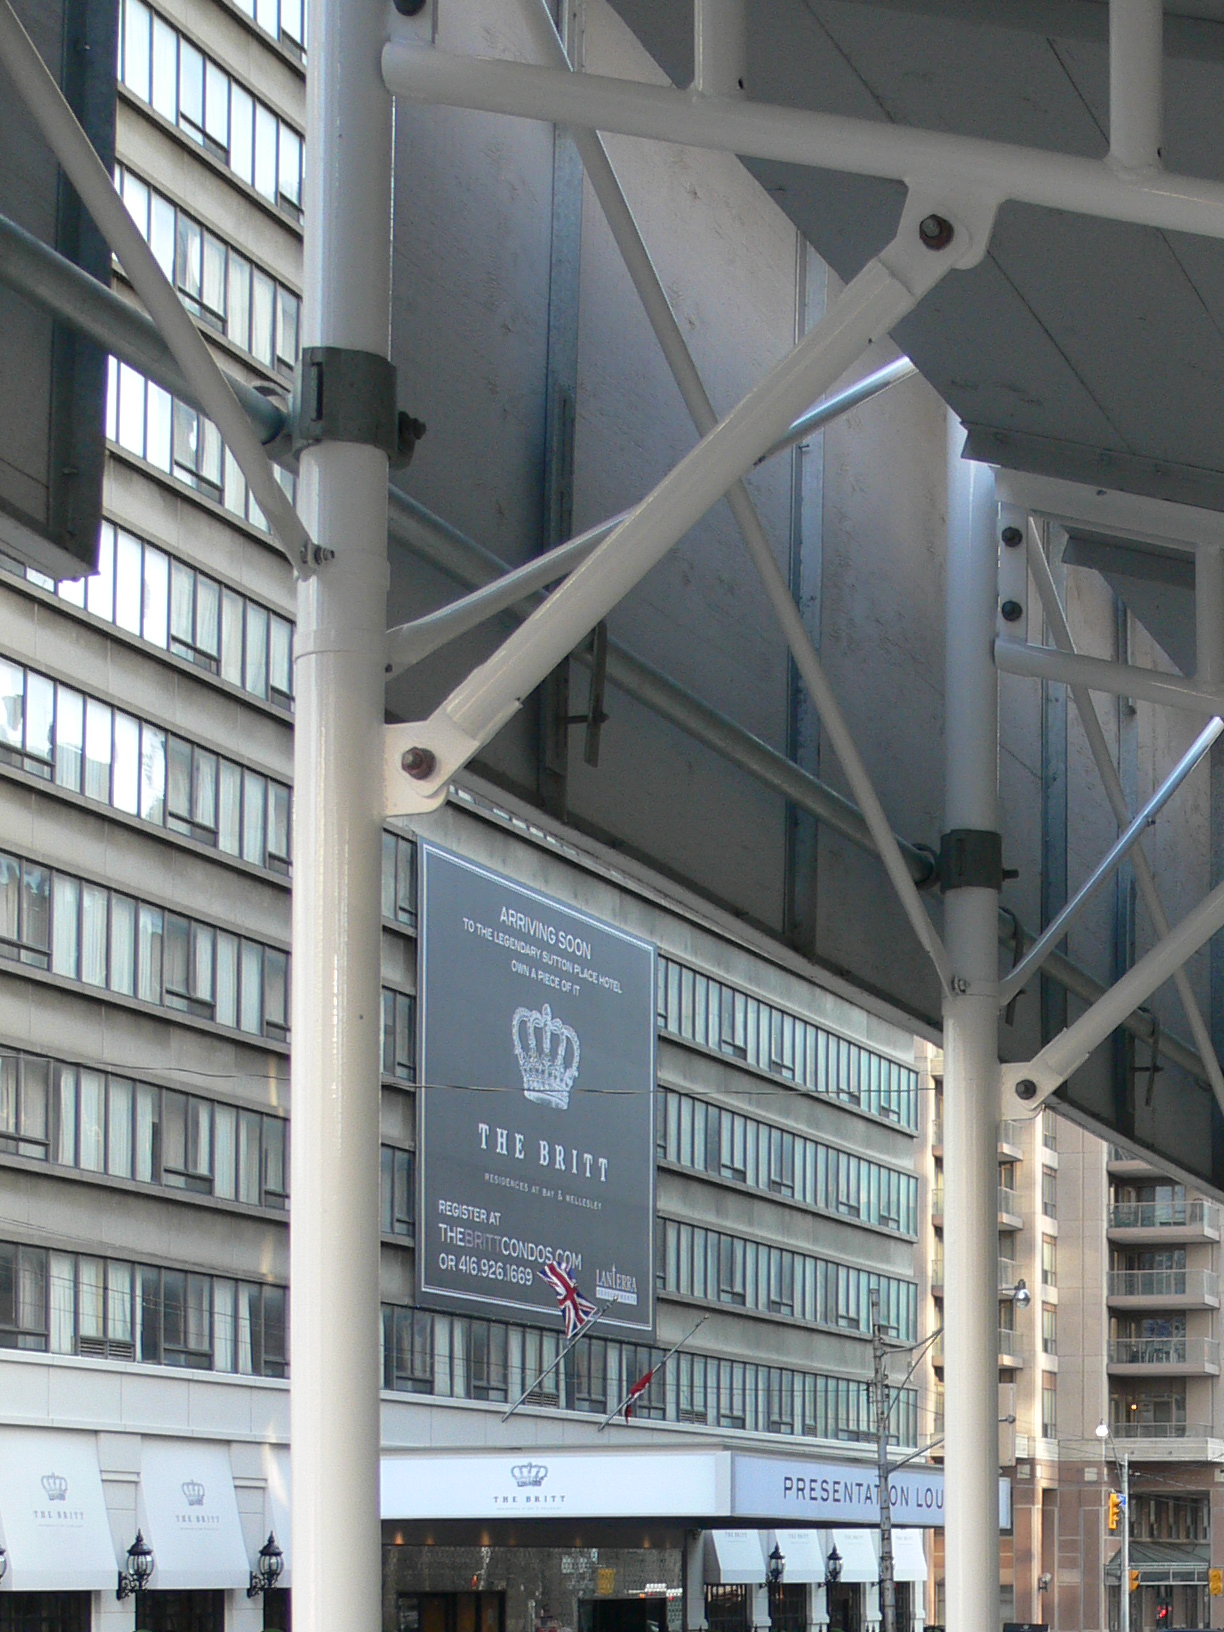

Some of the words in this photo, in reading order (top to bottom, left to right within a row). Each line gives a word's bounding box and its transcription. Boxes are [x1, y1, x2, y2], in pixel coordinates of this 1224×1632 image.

[500, 906, 556, 944] ARRIVING
[558, 931, 591, 960] SOON
[463, 917, 475, 932] TO
[476, 923, 493, 940] THE
[494, 931, 541, 960] LEGENDARY
[542, 951, 573, 974] SUTTON
[574, 964, 598, 984] PLACE
[599, 975, 623, 993] HOTEL
[511, 960, 529, 977] OWN
[531, 968, 537, 979] A
[538, 970, 560, 990] PIECE
[561, 979, 572, 993] OF
[573, 985, 581, 996] IT
[478, 1122, 525, 1159] THE
[539, 1140, 608, 1182] BRITT
[485, 1172, 529, 1193] RESIDENCES
[438, 1199, 487, 1224] REGISTER
[488, 1211, 501, 1226] AT
[439, 1253, 456, 1271] OR
[458, 1255, 533, 1286] 416.926.1669
[493, 1495, 518, 1503] THE
[526, 1495, 566, 1503] BRITT
[784, 1476, 909, 1508] PRESENTATON
